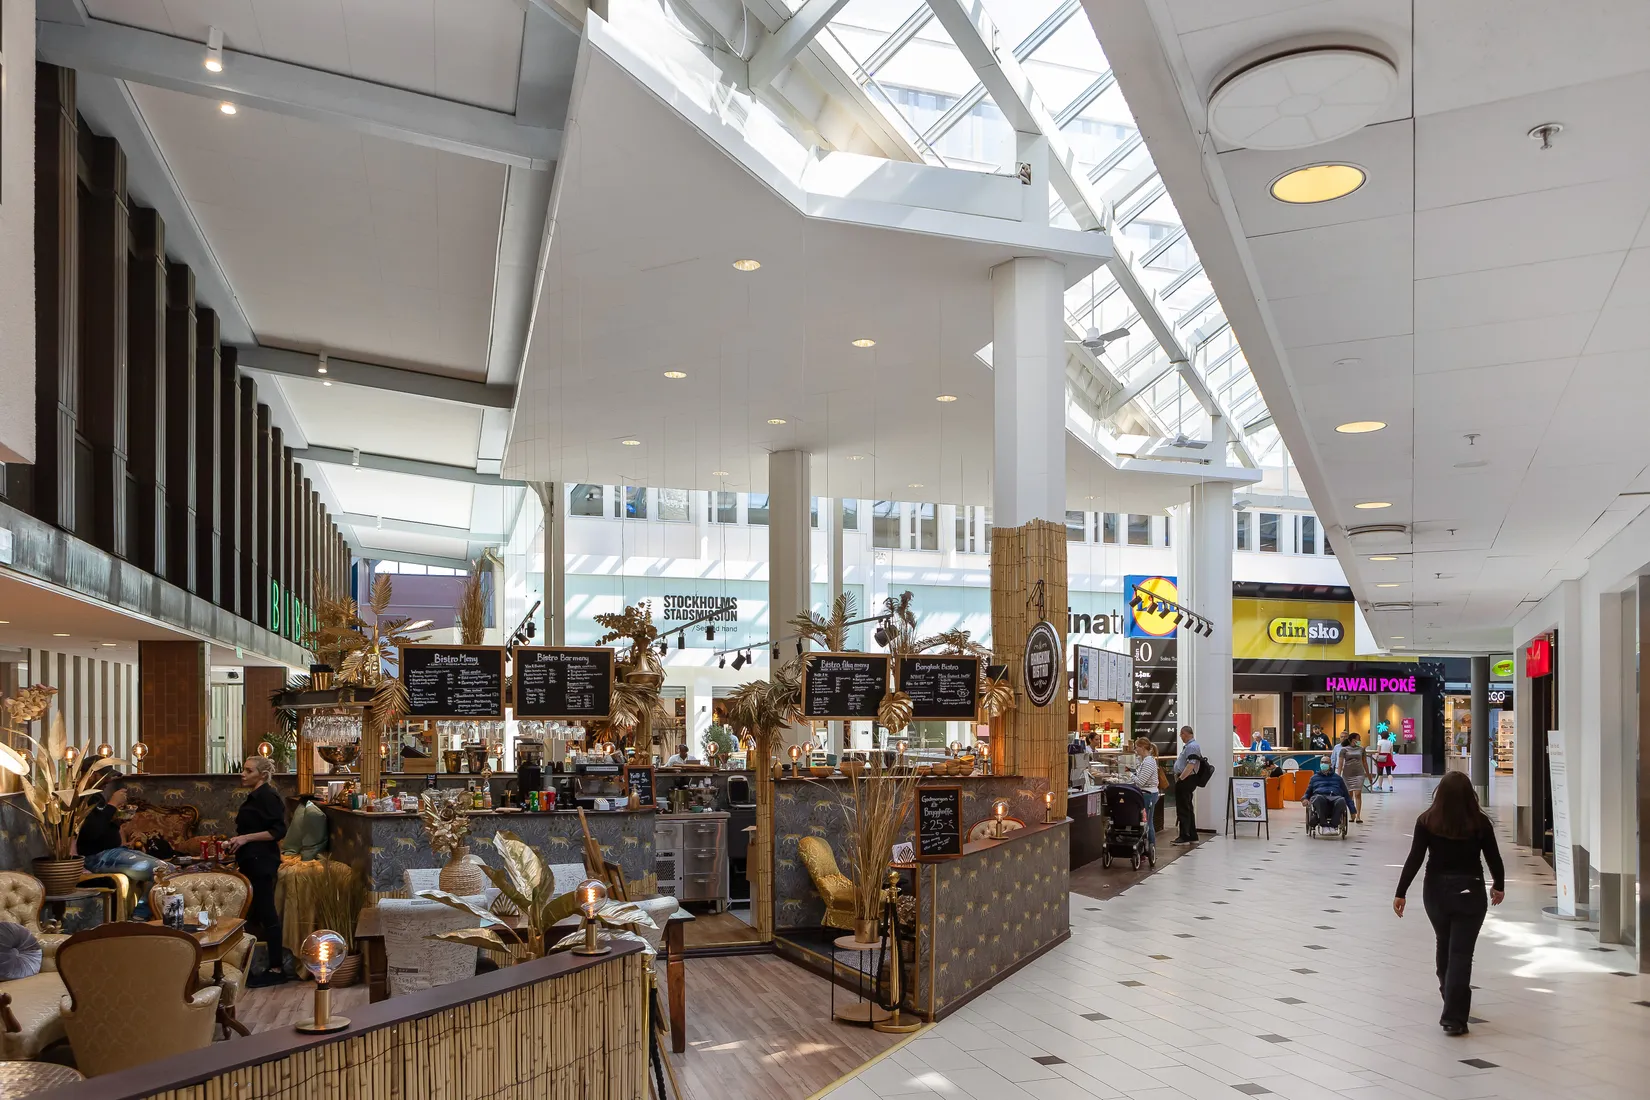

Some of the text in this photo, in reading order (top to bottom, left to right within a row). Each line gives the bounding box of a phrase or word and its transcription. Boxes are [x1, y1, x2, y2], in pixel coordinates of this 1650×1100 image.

[664, 595, 738, 609] STOCKHOLMS
[434, 653, 479, 665] Bistro Meny
[536, 652, 559, 662] Bistro
[1030, 650, 1050, 666] BANGKOK
[820, 659, 841, 669] Bistro
[915, 662, 959, 673] Bangkok Bistro
[1032, 664, 1049, 679] BISTRO
[1326, 677, 1377, 692] HAWAII
